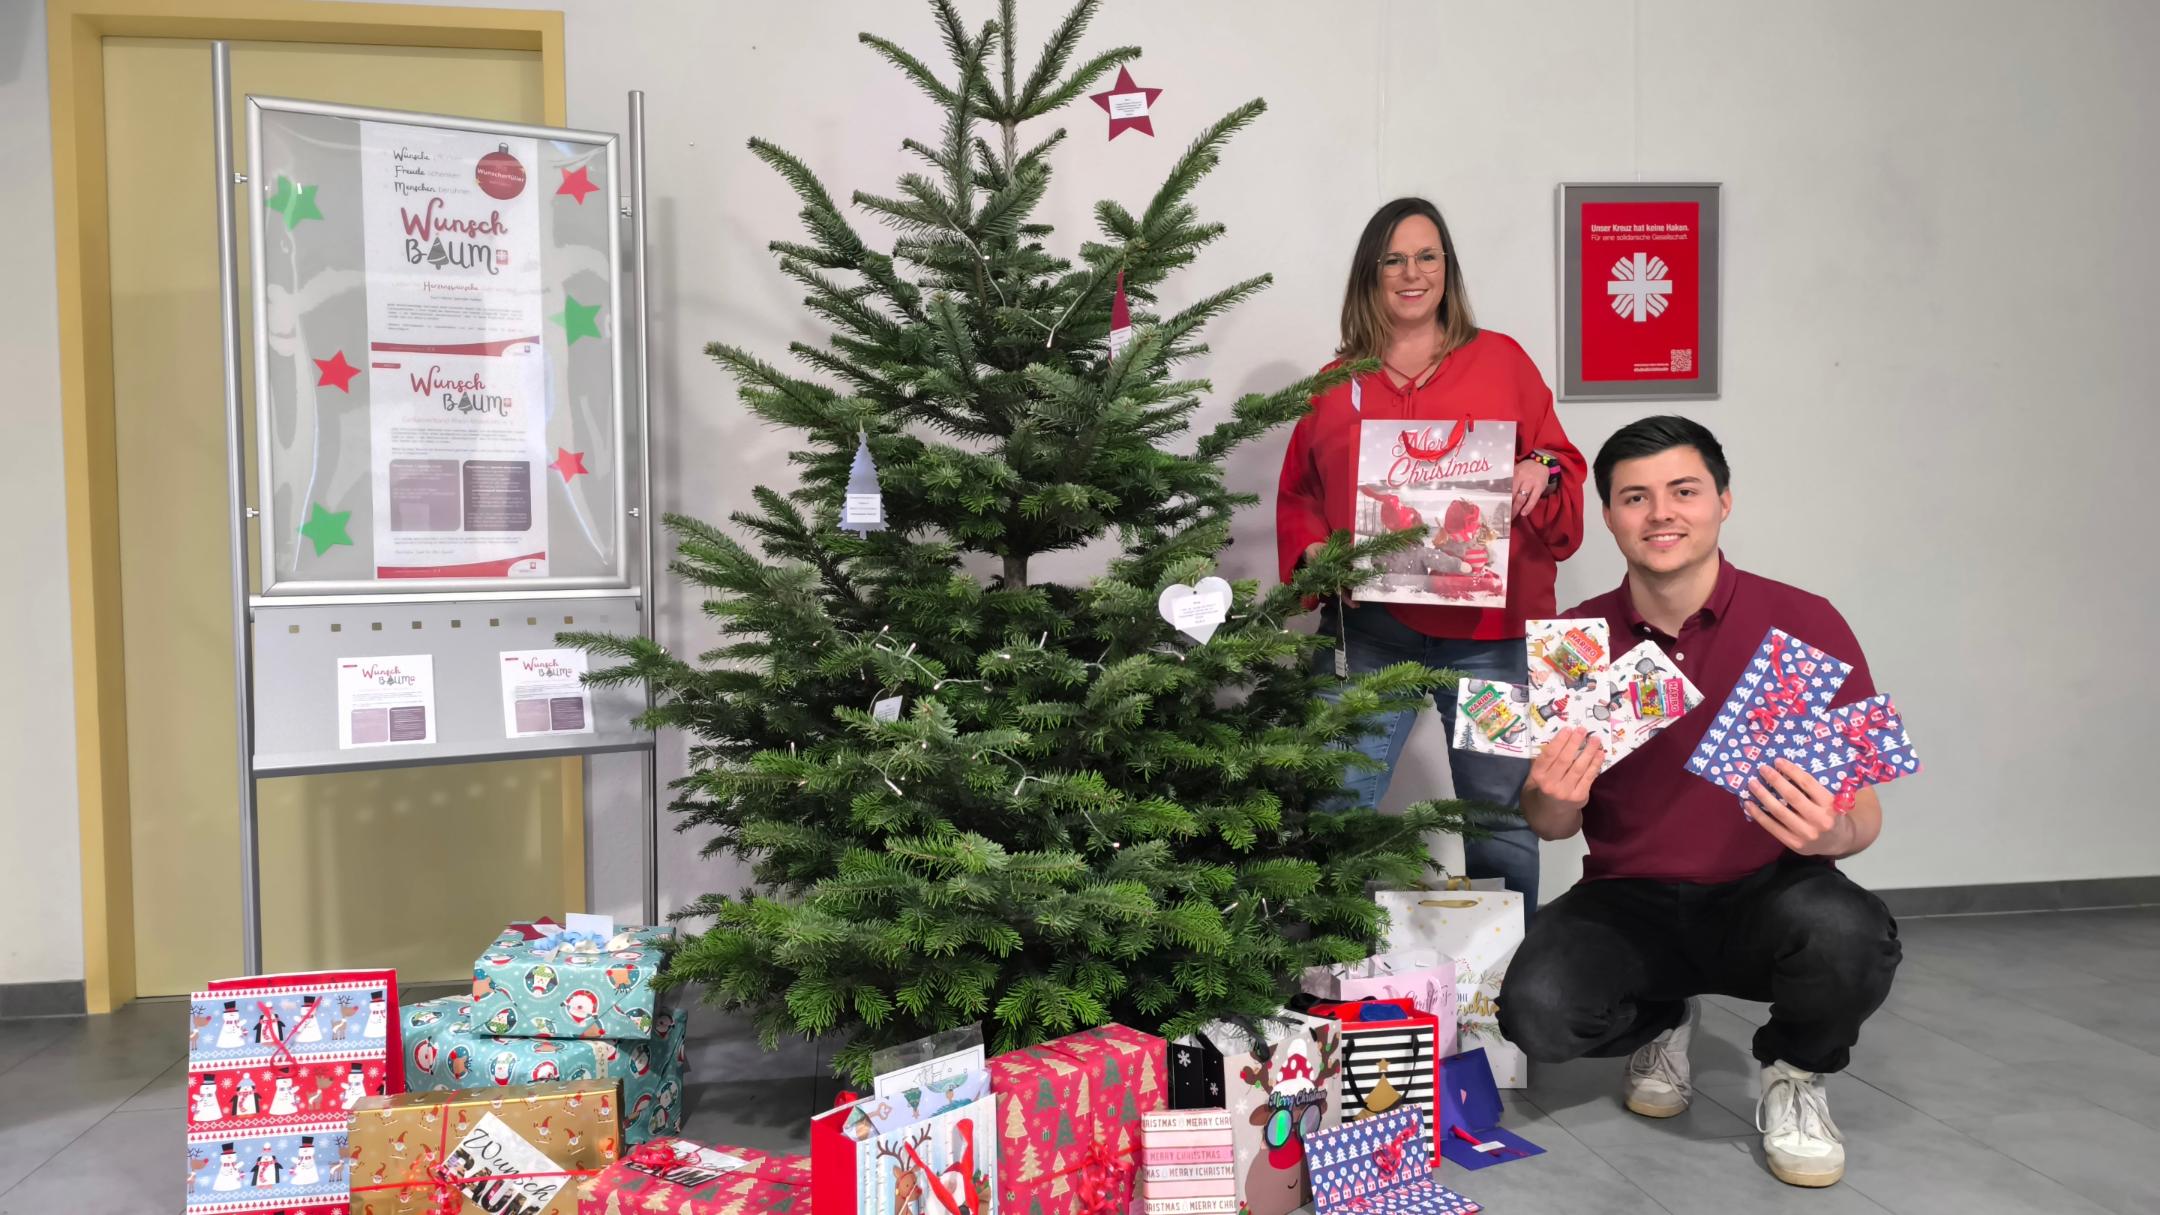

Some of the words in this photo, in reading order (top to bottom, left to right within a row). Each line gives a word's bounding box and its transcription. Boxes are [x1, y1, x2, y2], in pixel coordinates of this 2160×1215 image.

[400, 197, 508, 241] Wunsch
[1591, 224, 1611, 232] Unser
[1612, 224, 1632, 232] Kreuz
[1633, 224, 1645, 232] hat
[1646, 224, 1665, 232] keine
[410, 366, 486, 397] Wunsch
[1388, 456, 1493, 488] Christmas
[1570, 632, 1598, 657] HARIBO
[362, 664, 401, 679] Wunsch
[523, 657, 559, 671] Wunsch
[1469, 690, 1494, 713] HARIBO
[1670, 681, 1679, 713] HARIBO
